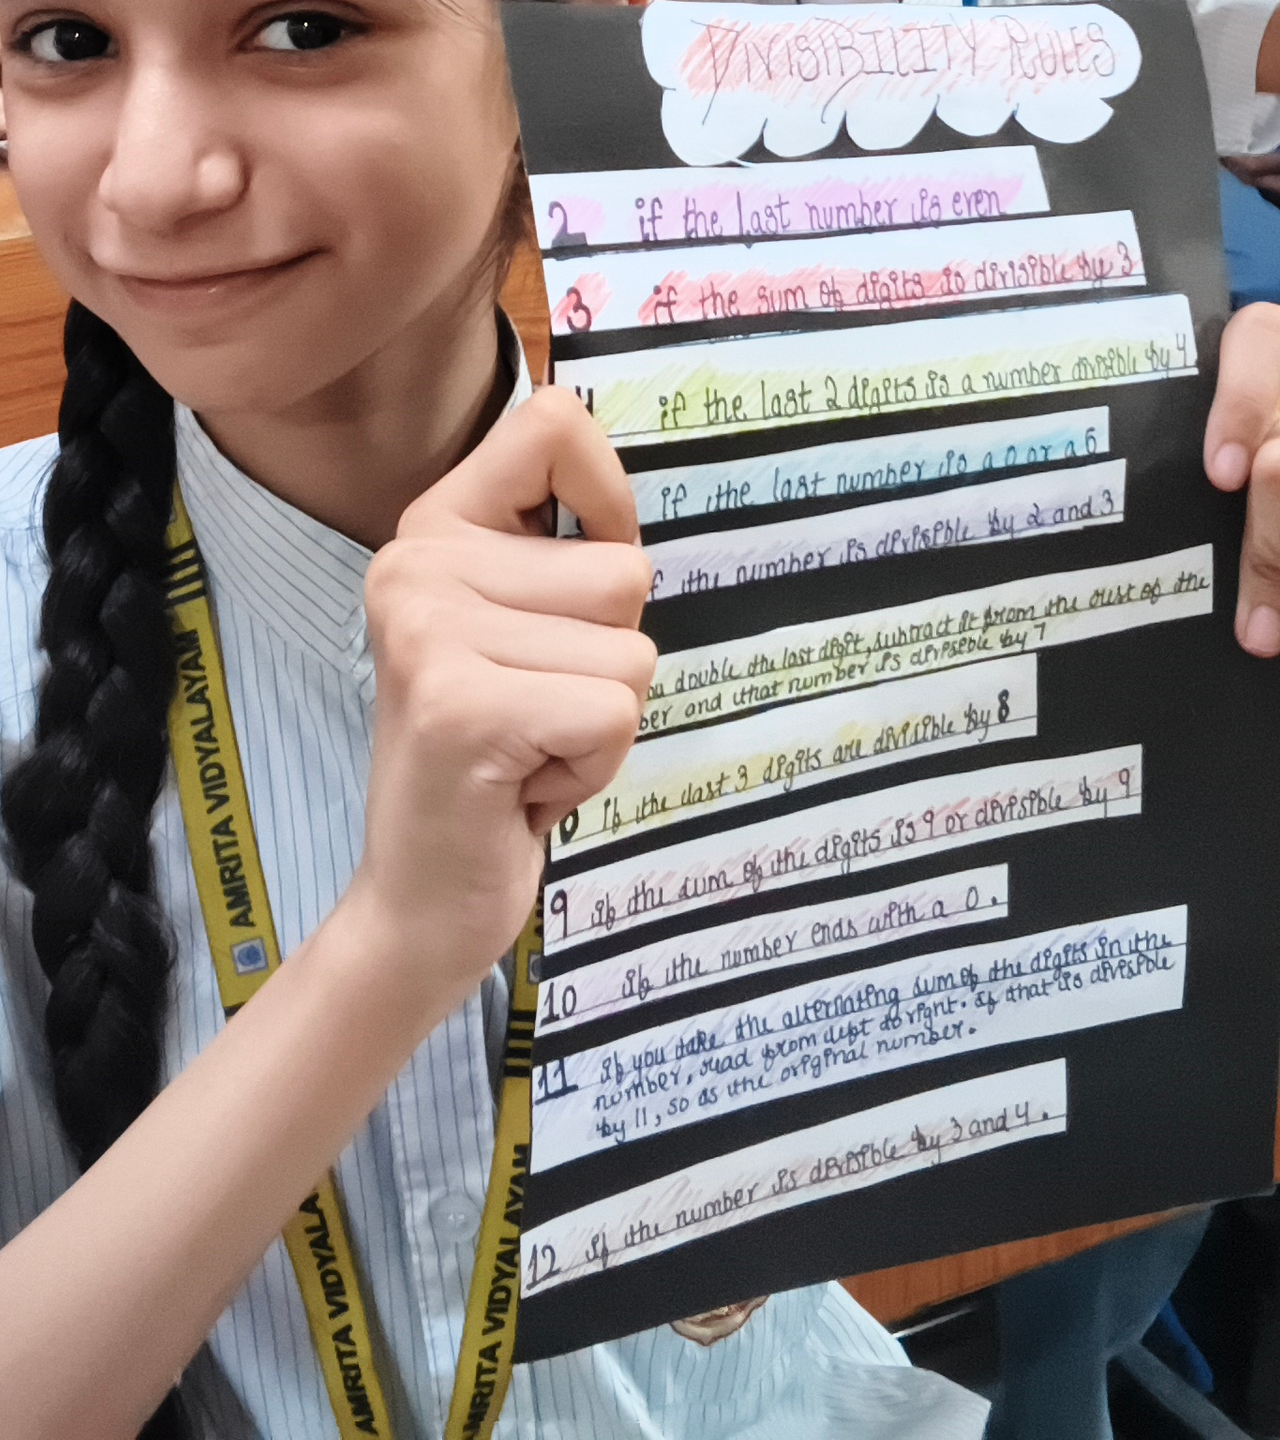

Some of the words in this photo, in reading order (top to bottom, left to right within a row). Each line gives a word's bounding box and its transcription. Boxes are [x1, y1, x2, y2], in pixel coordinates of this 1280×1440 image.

[990, 15, 1118, 79] RULES
[548, 200, 588, 249] 2
[635, 197, 663, 241] if
[683, 196, 723, 239] the
[736, 191, 791, 236] last
[805, 189, 897, 231] number
[951, 188, 1008, 217] even
[566, 286, 592, 332] 3
[698, 281, 738, 322] the
[757, 285, 811, 316] sum
[856, 269, 926, 310] digits
[1117, 240, 1134, 277] 3
[704, 386, 748, 424] the
[761, 380, 812, 420] last
[825, 375, 843, 410] 2
[961, 373, 979, 395] a
[983, 360, 1064, 391] number
[1175, 333, 1188, 368] 4
[706, 479, 756, 513] the
[773, 466, 827, 503] last
[837, 458, 926, 493] number
[982, 451, 995, 470] a
[1064, 439, 1077, 459] a
[736, 548, 832, 584] number
[1053, 495, 1094, 524] and
[1102, 488, 1116, 514] 3
[182, 627, 231, 814] VIDYALAYAM
[674, 657, 744, 692] double
[685, 694, 723, 719] and
[787, 660, 869, 692] number
[1034, 622, 1046, 641] 7
[635, 791, 671, 818] the
[735, 763, 749, 794] 3
[997, 688, 1011, 723] 8
[208, 814, 256, 930] AMRITA
[549, 889, 569, 939] 9
[678, 869, 735, 899] sum
[923, 810, 935, 839] 9
[945, 812, 968, 834] or
[1119, 767, 1131, 799] 9
[539, 981, 577, 1027] 10
[721, 929, 798, 971] number
[811, 917, 858, 947] ends
[868, 901, 925, 937] with
[932, 900, 949, 919] a
[534, 1057, 579, 1106] 11
[632, 1047, 665, 1083] you
[912, 975, 955, 998] sum
[668, 1097, 691, 1116] so
[298, 1191, 350, 1321] VIDYALA
[483, 1143, 531, 1339] VIDYALAYAM
[526, 1244, 560, 1291] 12
[676, 1184, 760, 1230] number
[950, 1118, 963, 1145] 3
[968, 1108, 1010, 1137] and
[331, 1323, 379, 1436] AMRITA
